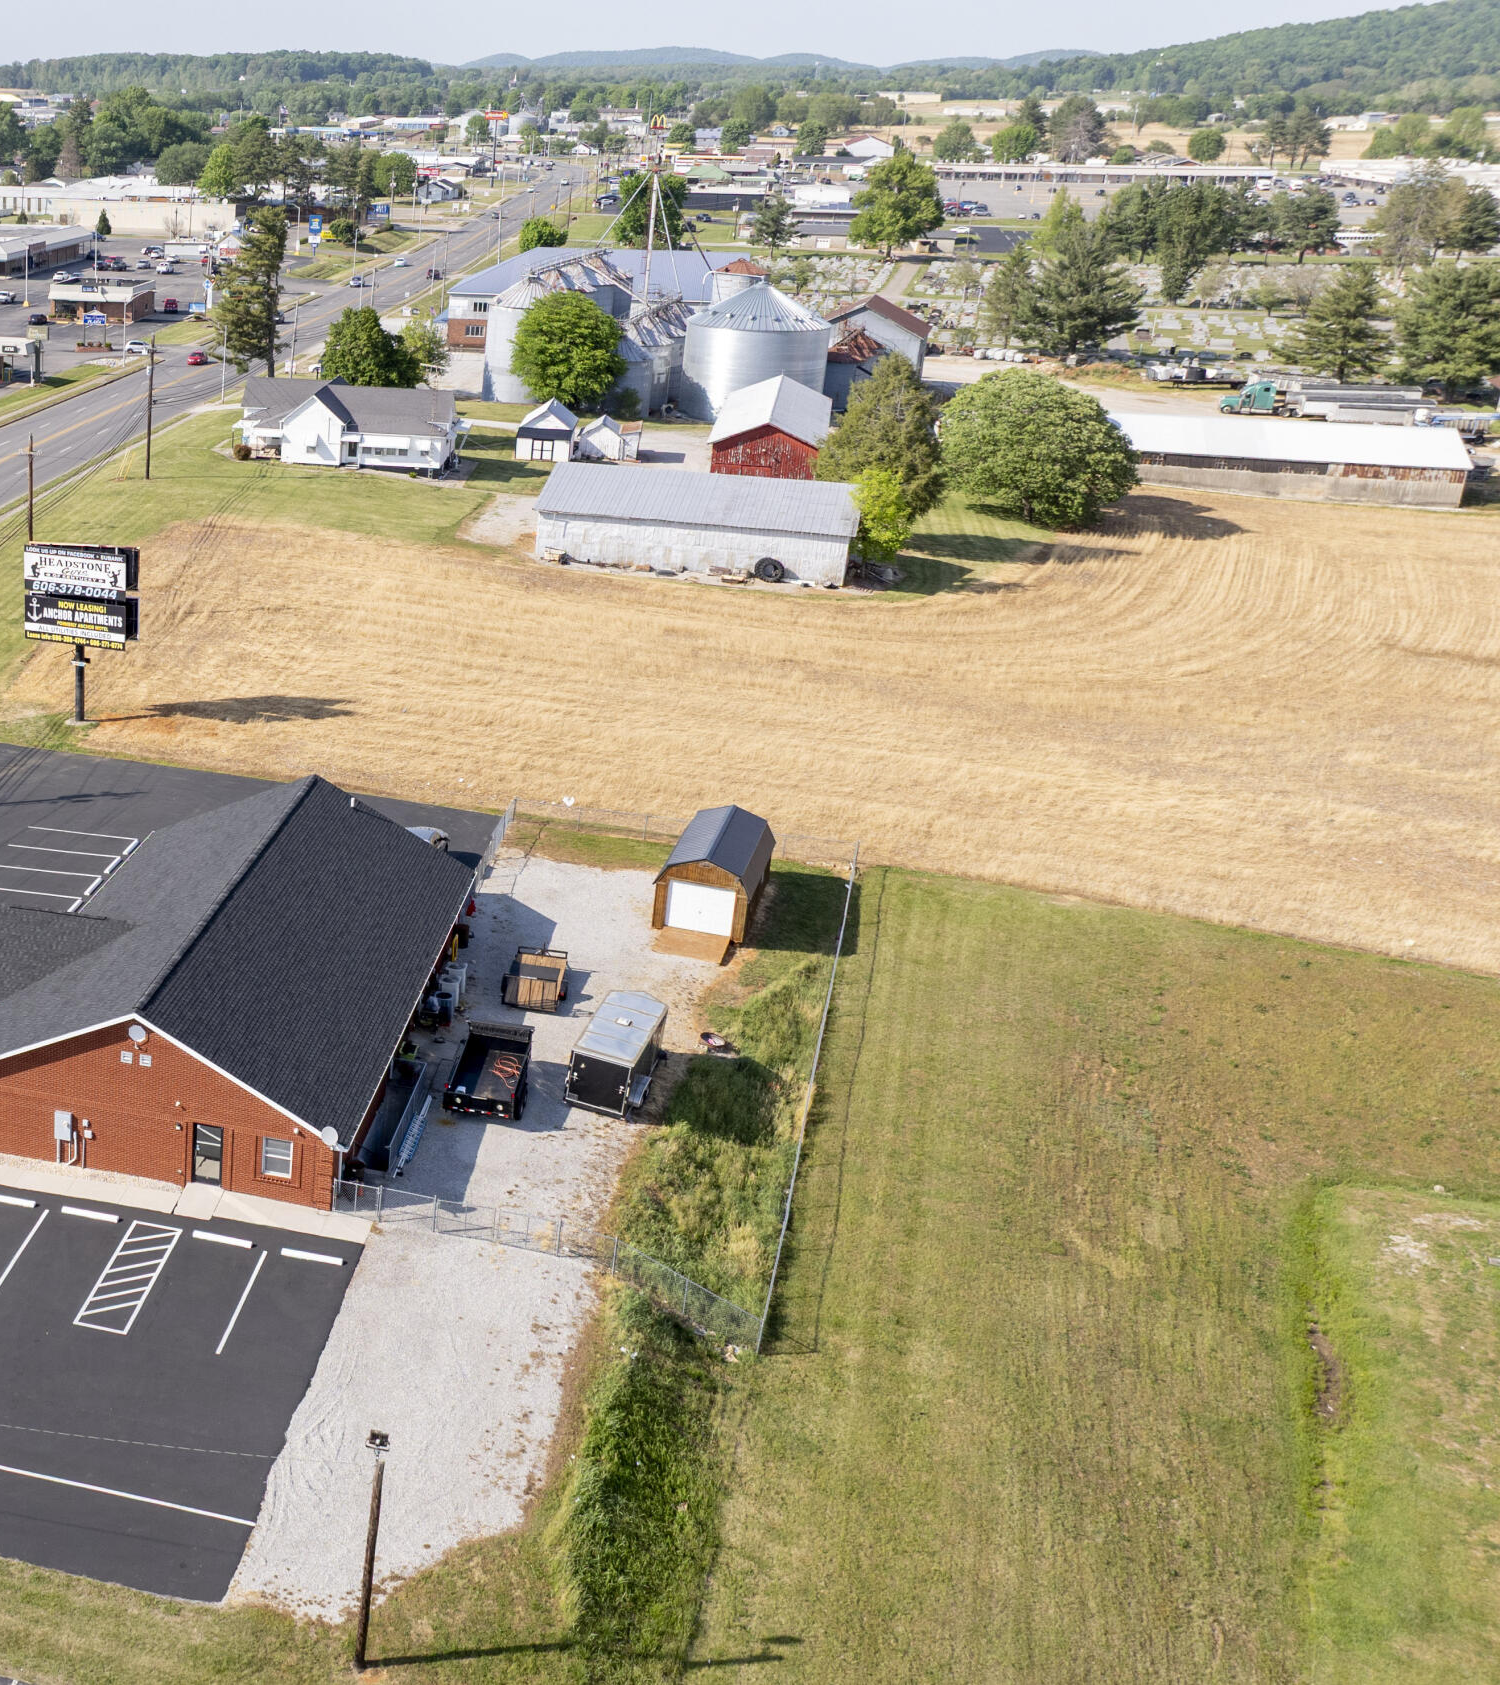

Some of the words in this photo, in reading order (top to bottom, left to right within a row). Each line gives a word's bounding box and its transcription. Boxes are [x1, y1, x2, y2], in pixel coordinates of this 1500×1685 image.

[67, 551, 95, 559] FACEBOOK
[39, 556, 112, 574] HEADSTONE
[32, 580, 118, 599] 606-379-0044
[58, 601, 75, 610] NOW
[76, 603, 106, 614] LEASING!
[43, 607, 73, 621] ANCHOR
[74, 611, 123, 628] APARTMENTS
[51, 627, 79, 635] UTILITIES
[80, 630, 111, 639] INCLUDED
